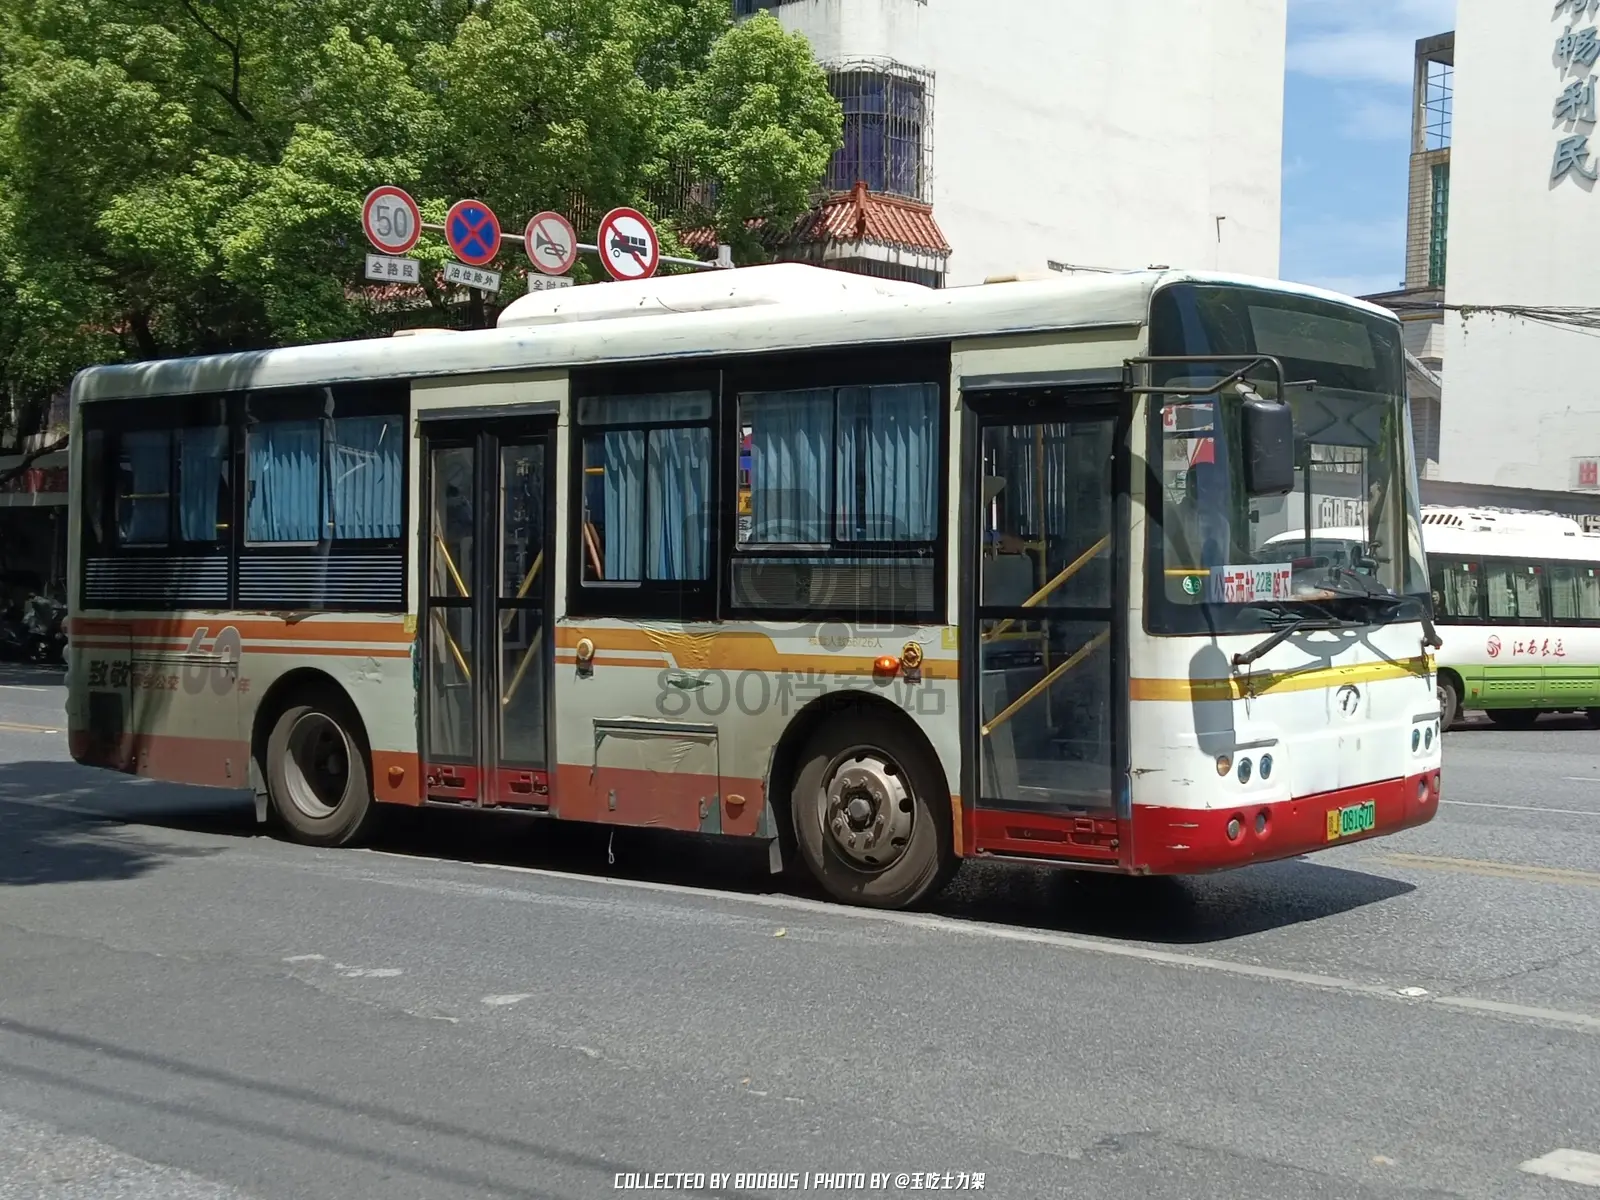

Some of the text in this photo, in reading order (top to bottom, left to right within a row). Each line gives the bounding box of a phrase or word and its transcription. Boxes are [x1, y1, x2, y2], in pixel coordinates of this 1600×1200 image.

[1552, 0, 1600, 180] 畅利民
[376, 205, 408, 238] 50
[372, 262, 413, 277] 全路段
[451, 267, 494, 286] 泊位除外
[87, 660, 132, 689] 致敬
[237, 676, 250, 694] 年
